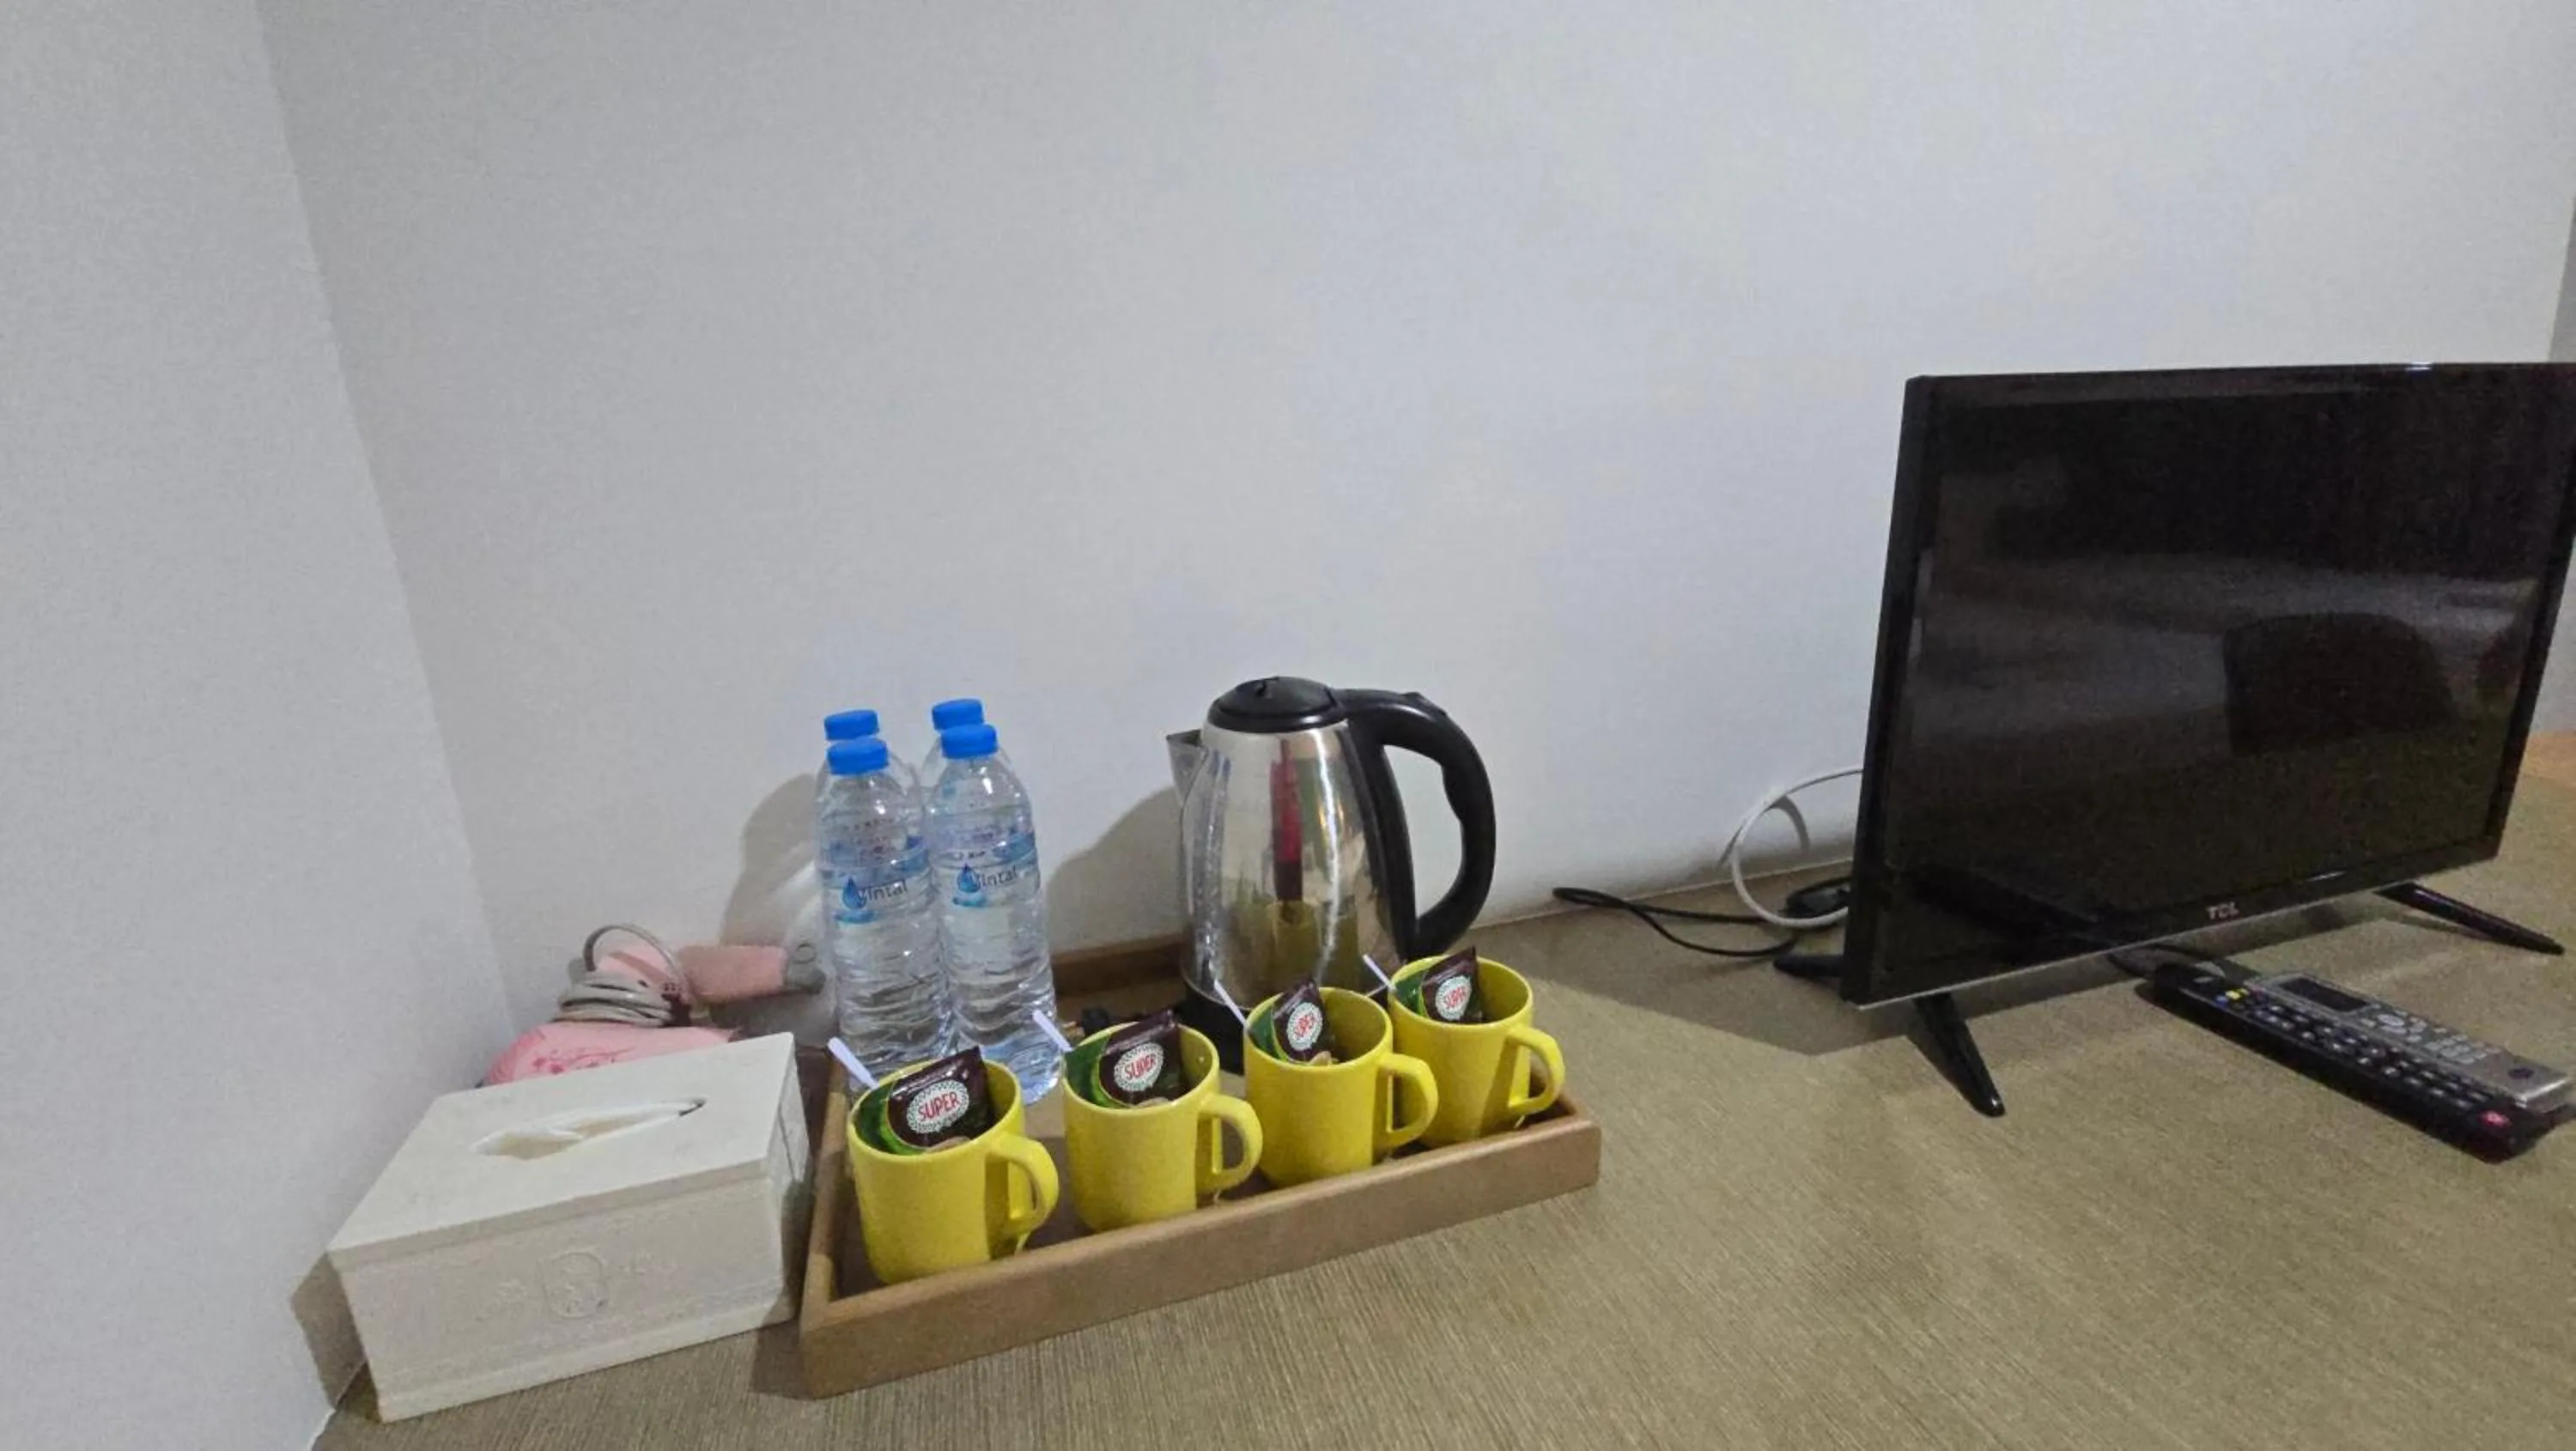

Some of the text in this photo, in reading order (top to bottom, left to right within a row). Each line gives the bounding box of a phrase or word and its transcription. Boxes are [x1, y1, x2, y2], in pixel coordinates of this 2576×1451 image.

[2206, 902, 2239, 920] TCL
[1125, 1053, 1157, 1080] SUPER
[917, 1091, 960, 1122] SUPER
